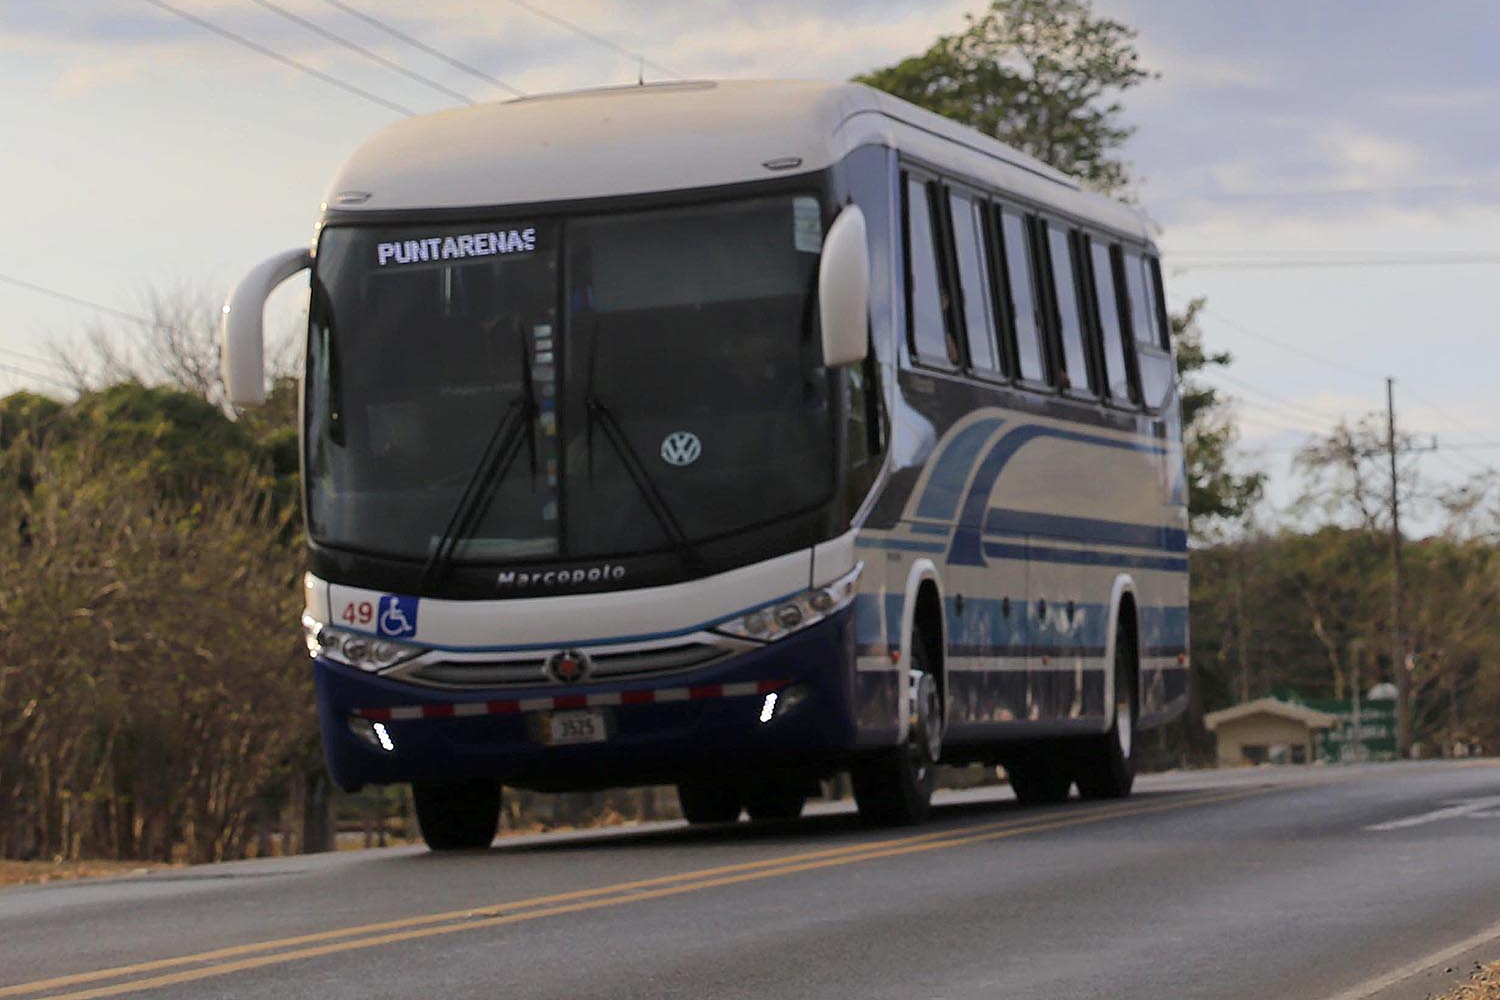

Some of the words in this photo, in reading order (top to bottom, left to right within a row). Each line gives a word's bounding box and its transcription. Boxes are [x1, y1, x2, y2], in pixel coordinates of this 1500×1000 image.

[377, 228, 536, 265] PUNTARENAS
[497, 563, 626, 585] Marcopolo
[342, 601, 373, 625] 49
